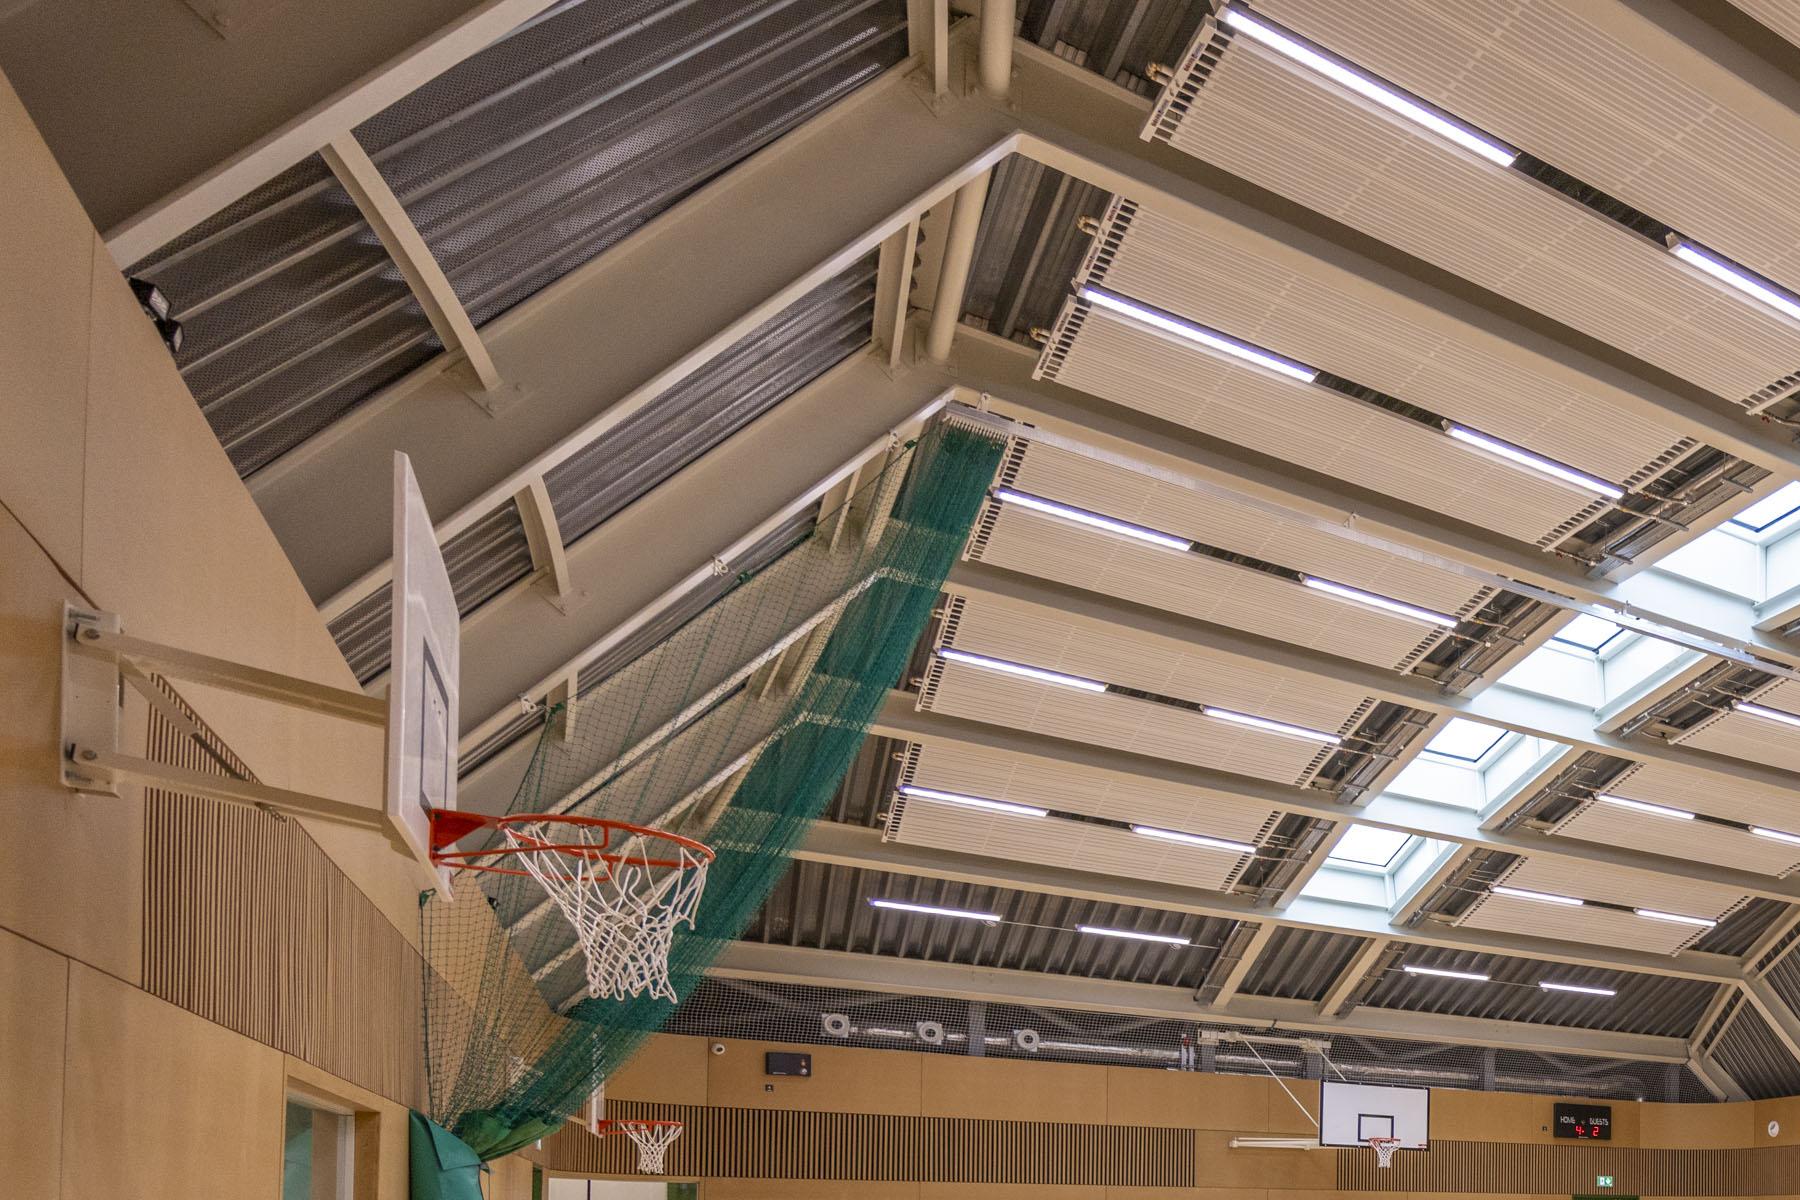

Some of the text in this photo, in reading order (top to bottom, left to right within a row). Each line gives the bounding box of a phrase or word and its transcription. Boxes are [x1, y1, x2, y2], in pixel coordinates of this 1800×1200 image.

[1560, 1115, 1609, 1126] HOME GUESTS
[1592, 1126, 1599, 1137] 2
